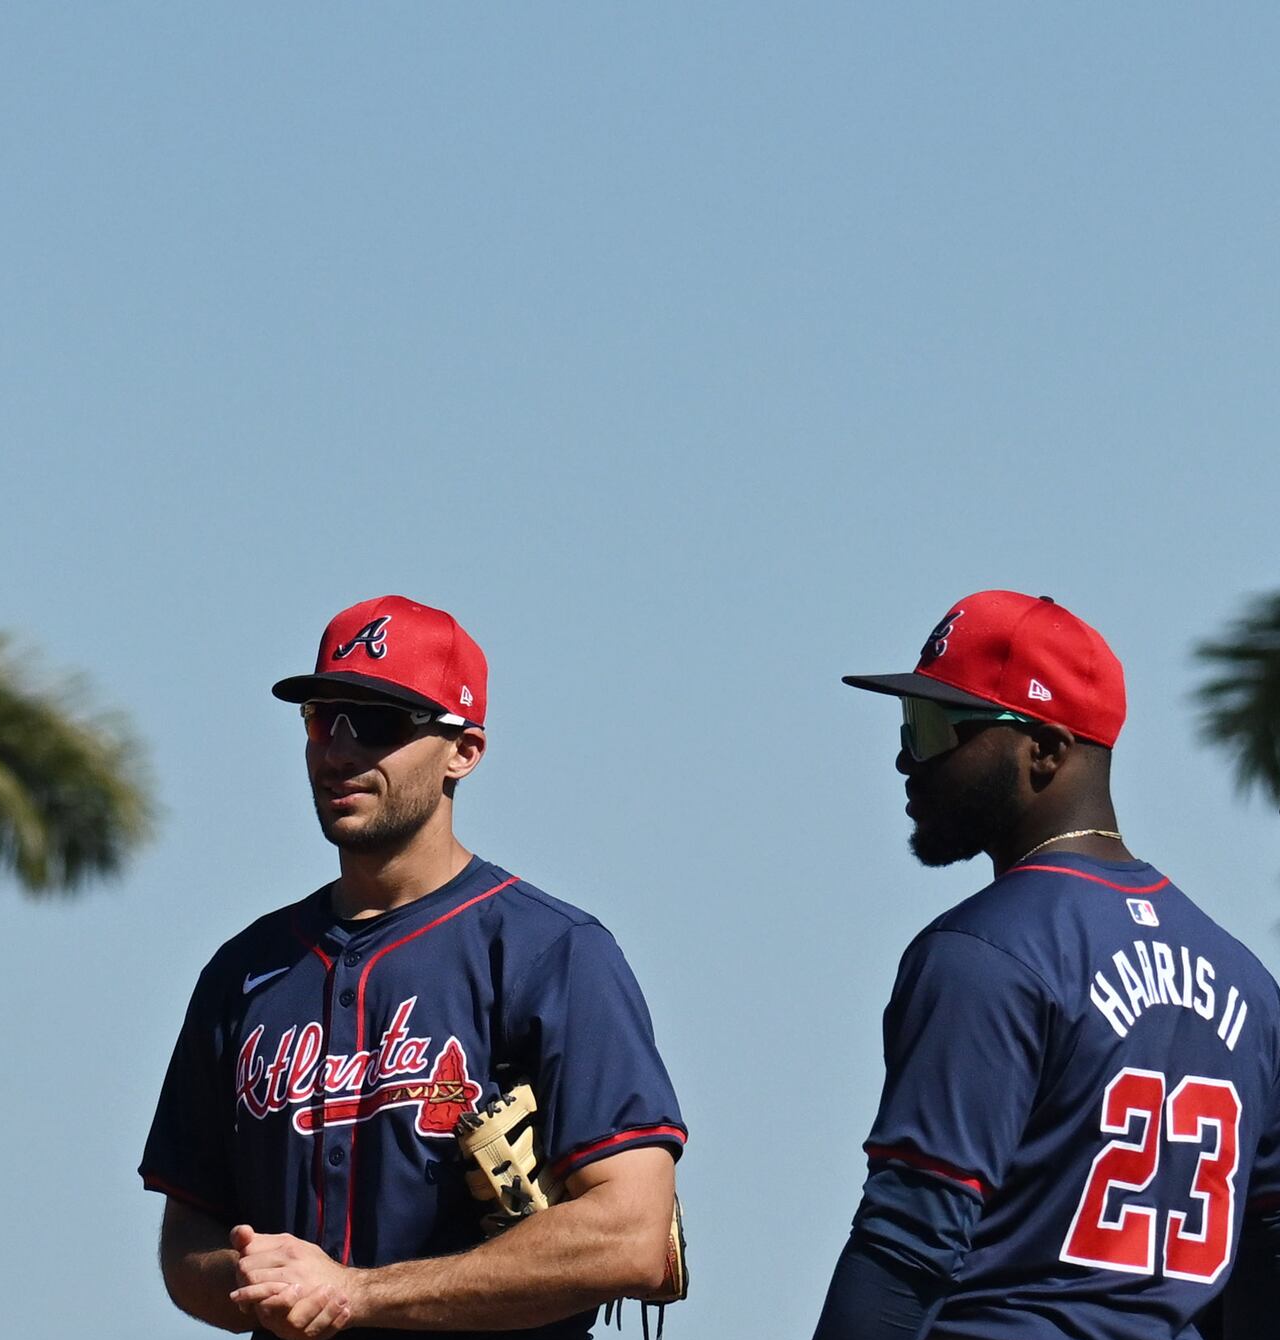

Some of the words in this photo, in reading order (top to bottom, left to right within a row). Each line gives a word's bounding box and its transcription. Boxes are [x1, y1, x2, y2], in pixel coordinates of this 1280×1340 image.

[332, 614, 392, 660] A
[1090, 940, 1216, 1038] HARRIS
[1217, 986, 1248, 1052] II
[235, 995, 432, 1121] Atlanta
[1059, 1066, 1243, 1285] 23
